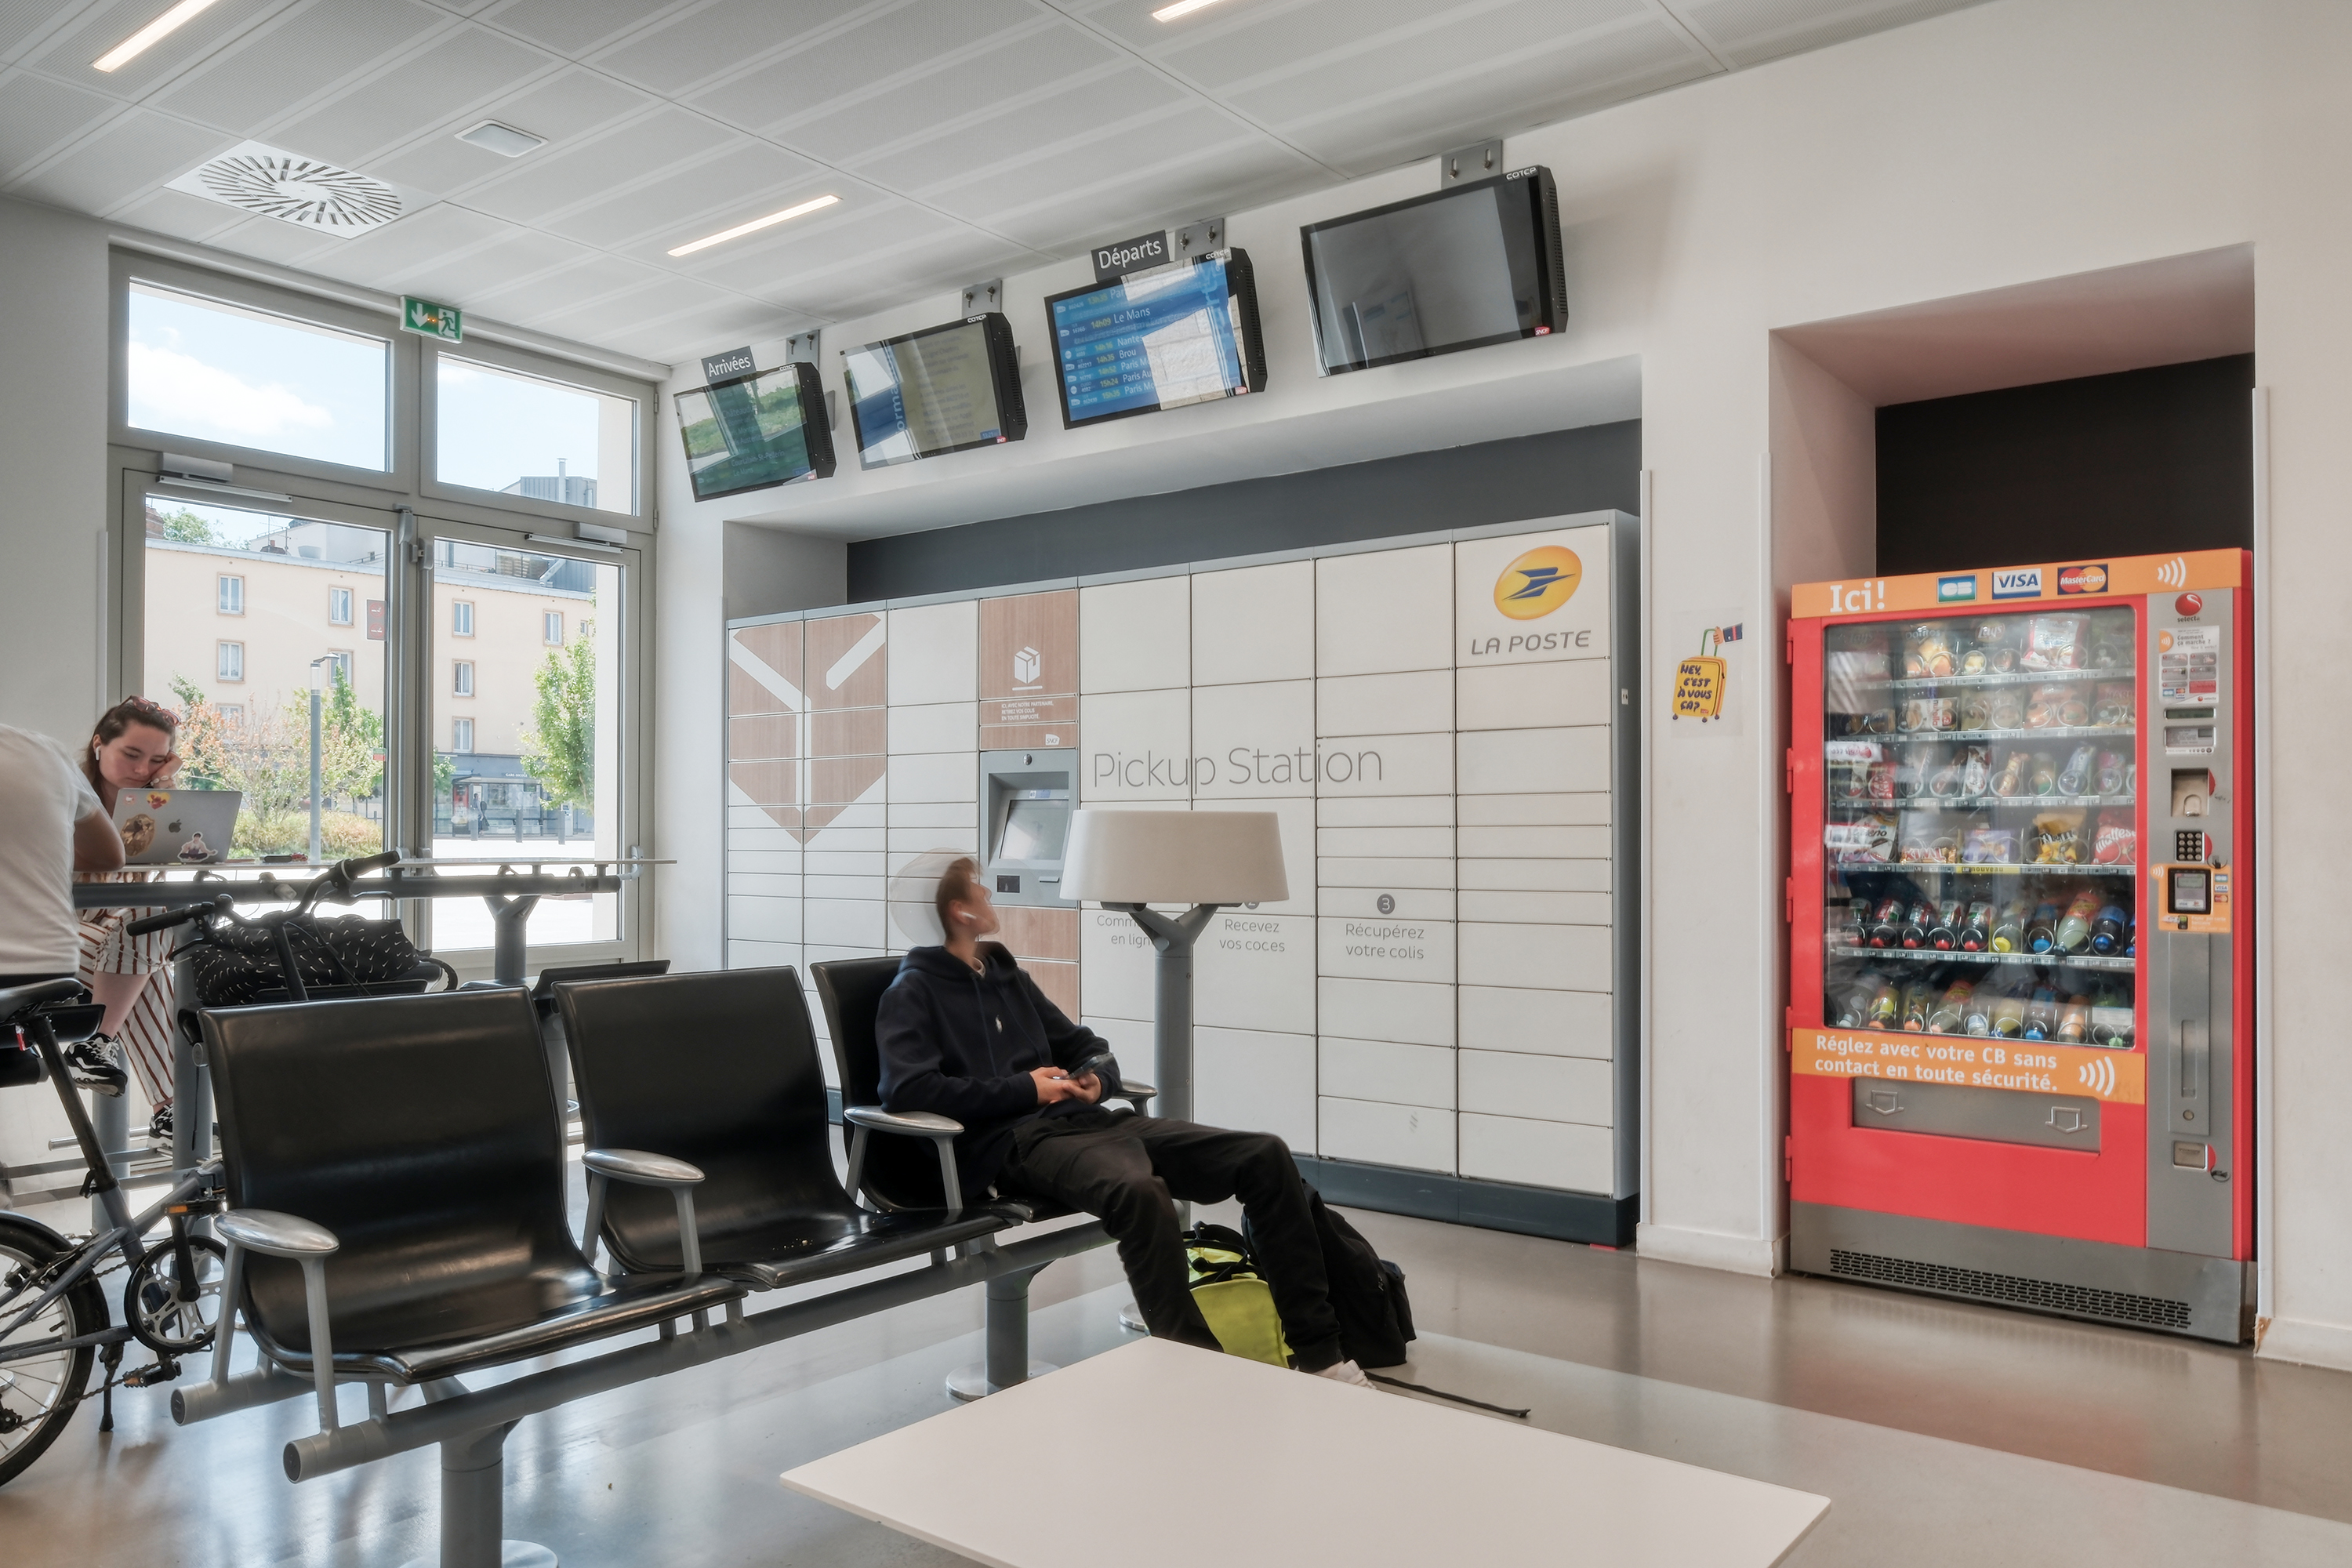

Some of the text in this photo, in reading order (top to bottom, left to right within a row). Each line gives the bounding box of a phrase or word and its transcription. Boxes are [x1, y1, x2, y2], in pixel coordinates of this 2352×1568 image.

[1098, 238, 1162, 270] Départs
[1113, 307, 1151, 325] Le Mans
[1116, 335, 1143, 347] Nantes
[1119, 348, 1137, 359] Brou
[708, 356, 751, 378] Arrivées
[1120, 361, 1139, 371] Paris
[1123, 372, 1141, 383] Paris
[1123, 385, 1142, 394] Paris
[1998, 572, 2039, 589] VISA
[2060, 573, 2106, 586] MasterCard
[1829, 580, 1886, 613] Ici!
[1471, 630, 1592, 655] LA POSTE
[1687, 689, 1712, 700] VOUS
[1094, 744, 1382, 795] Pickup Station
[1097, 914, 1138, 927] Comm
[1225, 918, 1279, 933] Recevez
[1345, 923, 1425, 941] Récupérez
[1111, 934, 1151, 948] en lign
[1219, 939, 1242, 950] vos
[1345, 944, 1425, 960] votre colis
[1816, 1034, 2057, 1069] Réglez avec votre CB sans
[1814, 1057, 2058, 1091] contact en toute sécurité.
